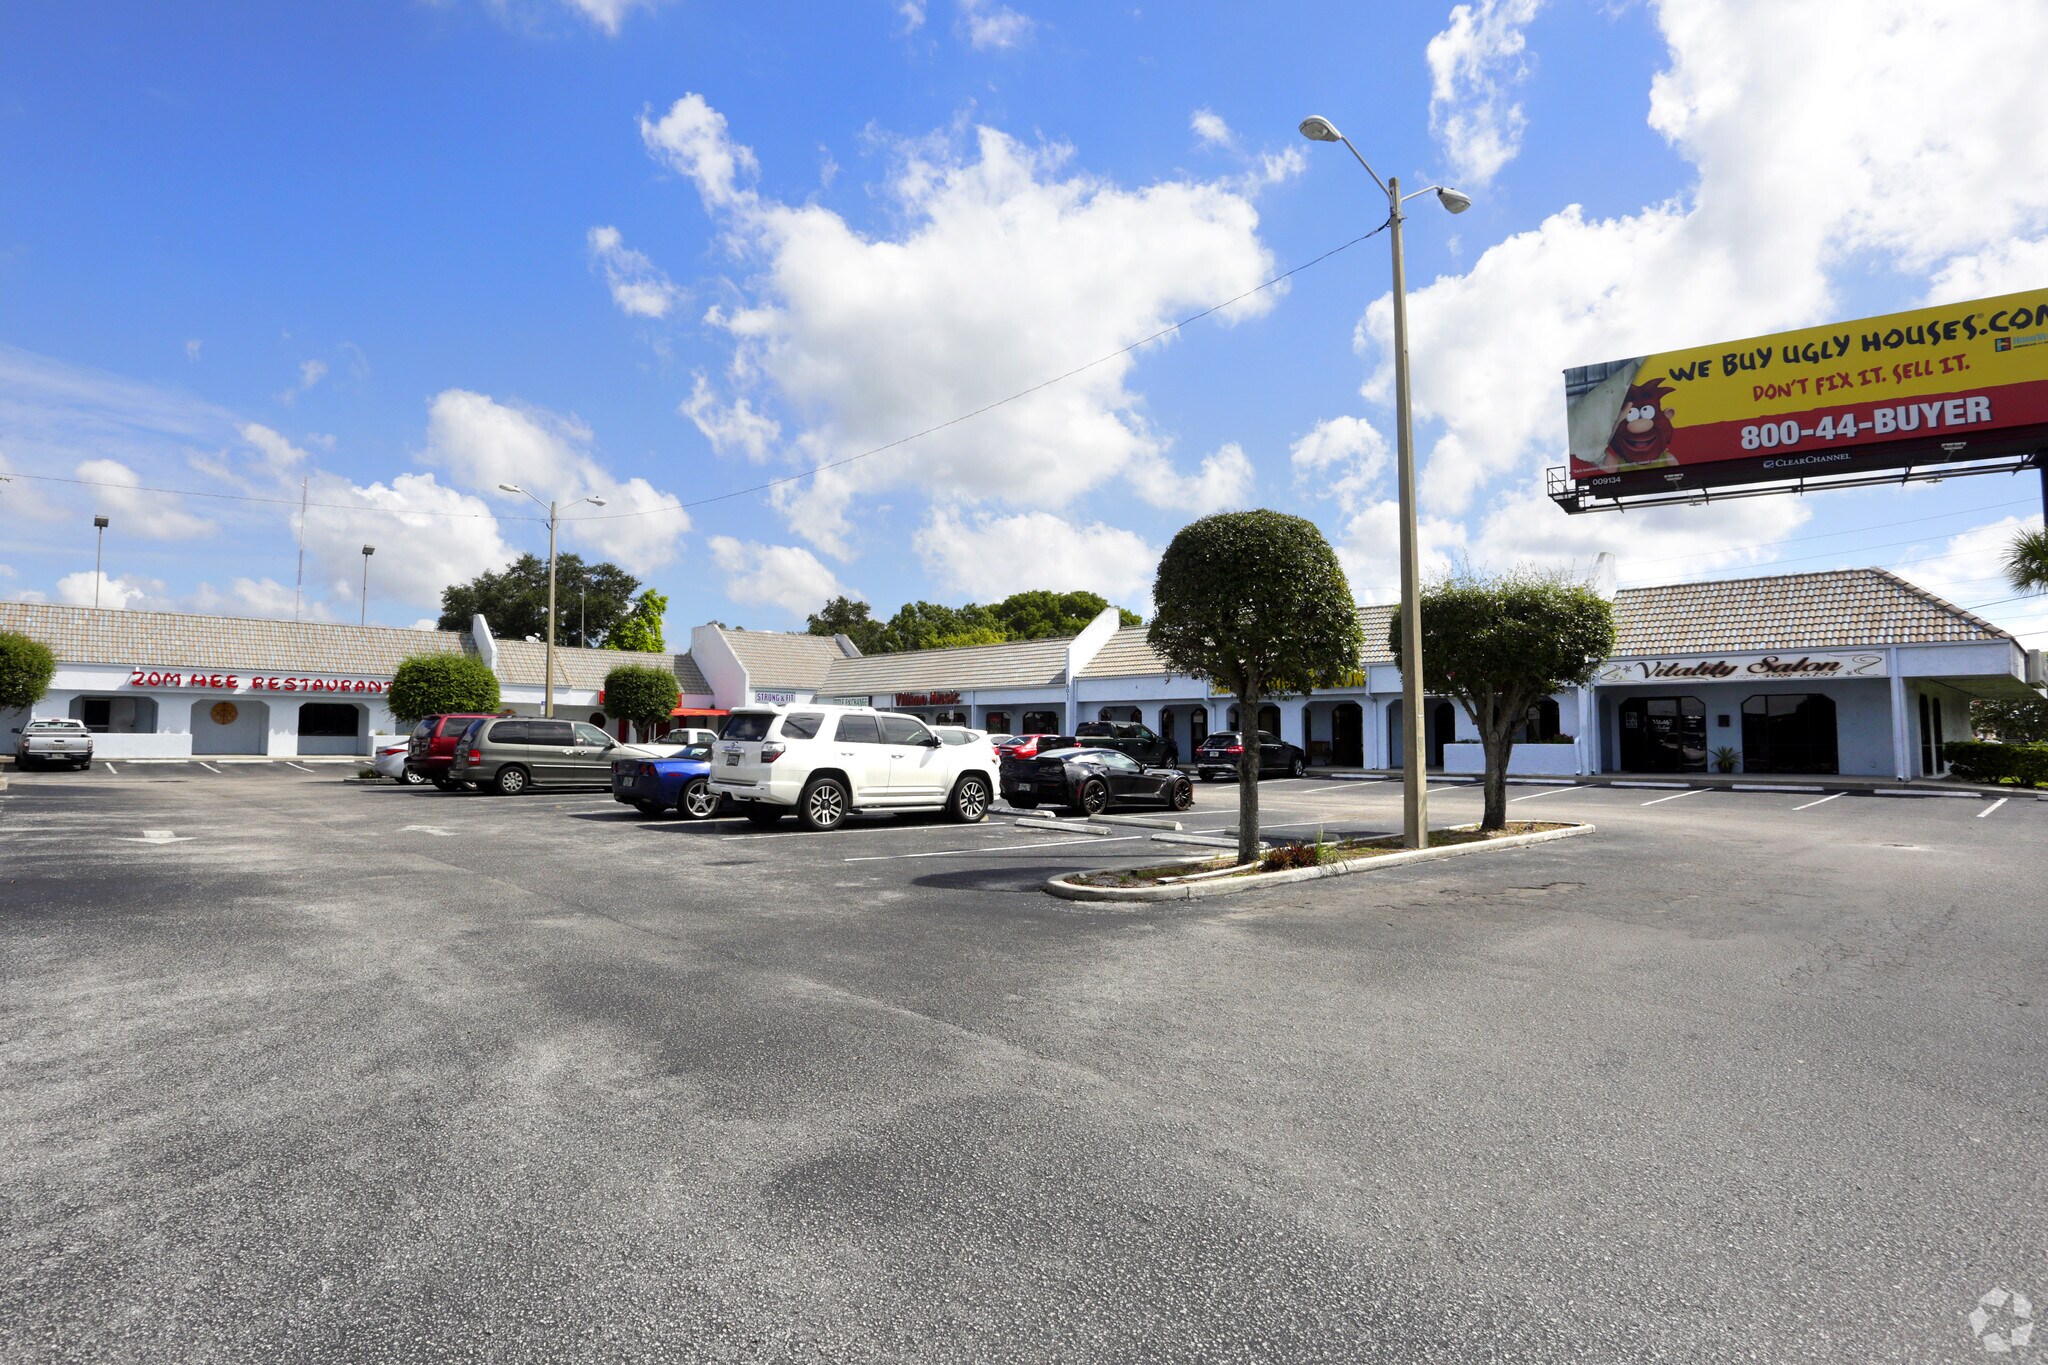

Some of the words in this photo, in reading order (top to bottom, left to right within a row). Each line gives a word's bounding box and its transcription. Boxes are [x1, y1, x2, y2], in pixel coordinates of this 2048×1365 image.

[1669, 360, 1712, 381] WE
[1722, 346, 1772, 377] BUY
[1783, 334, 1850, 364] UGLY
[1753, 378, 1808, 402] DON'T
[1815, 372, 1853, 395] FIX
[1857, 366, 1887, 386] IT.
[1892, 359, 1934, 385] SELL
[1938, 353, 1971, 375] IT.
[1741, 395, 1992, 449] 800-44-BUYER
[1592, 476, 1621, 486] 009134
[1635, 660, 1738, 677] Vitality
[1747, 656, 1843, 673] Salon
[131, 671, 181, 687] ZOM
[191, 673, 240, 689] HEE
[252, 676, 394, 693] RESTAURANT
[757, 692, 780, 702] STRONG
[785, 692, 794, 702] FIT
